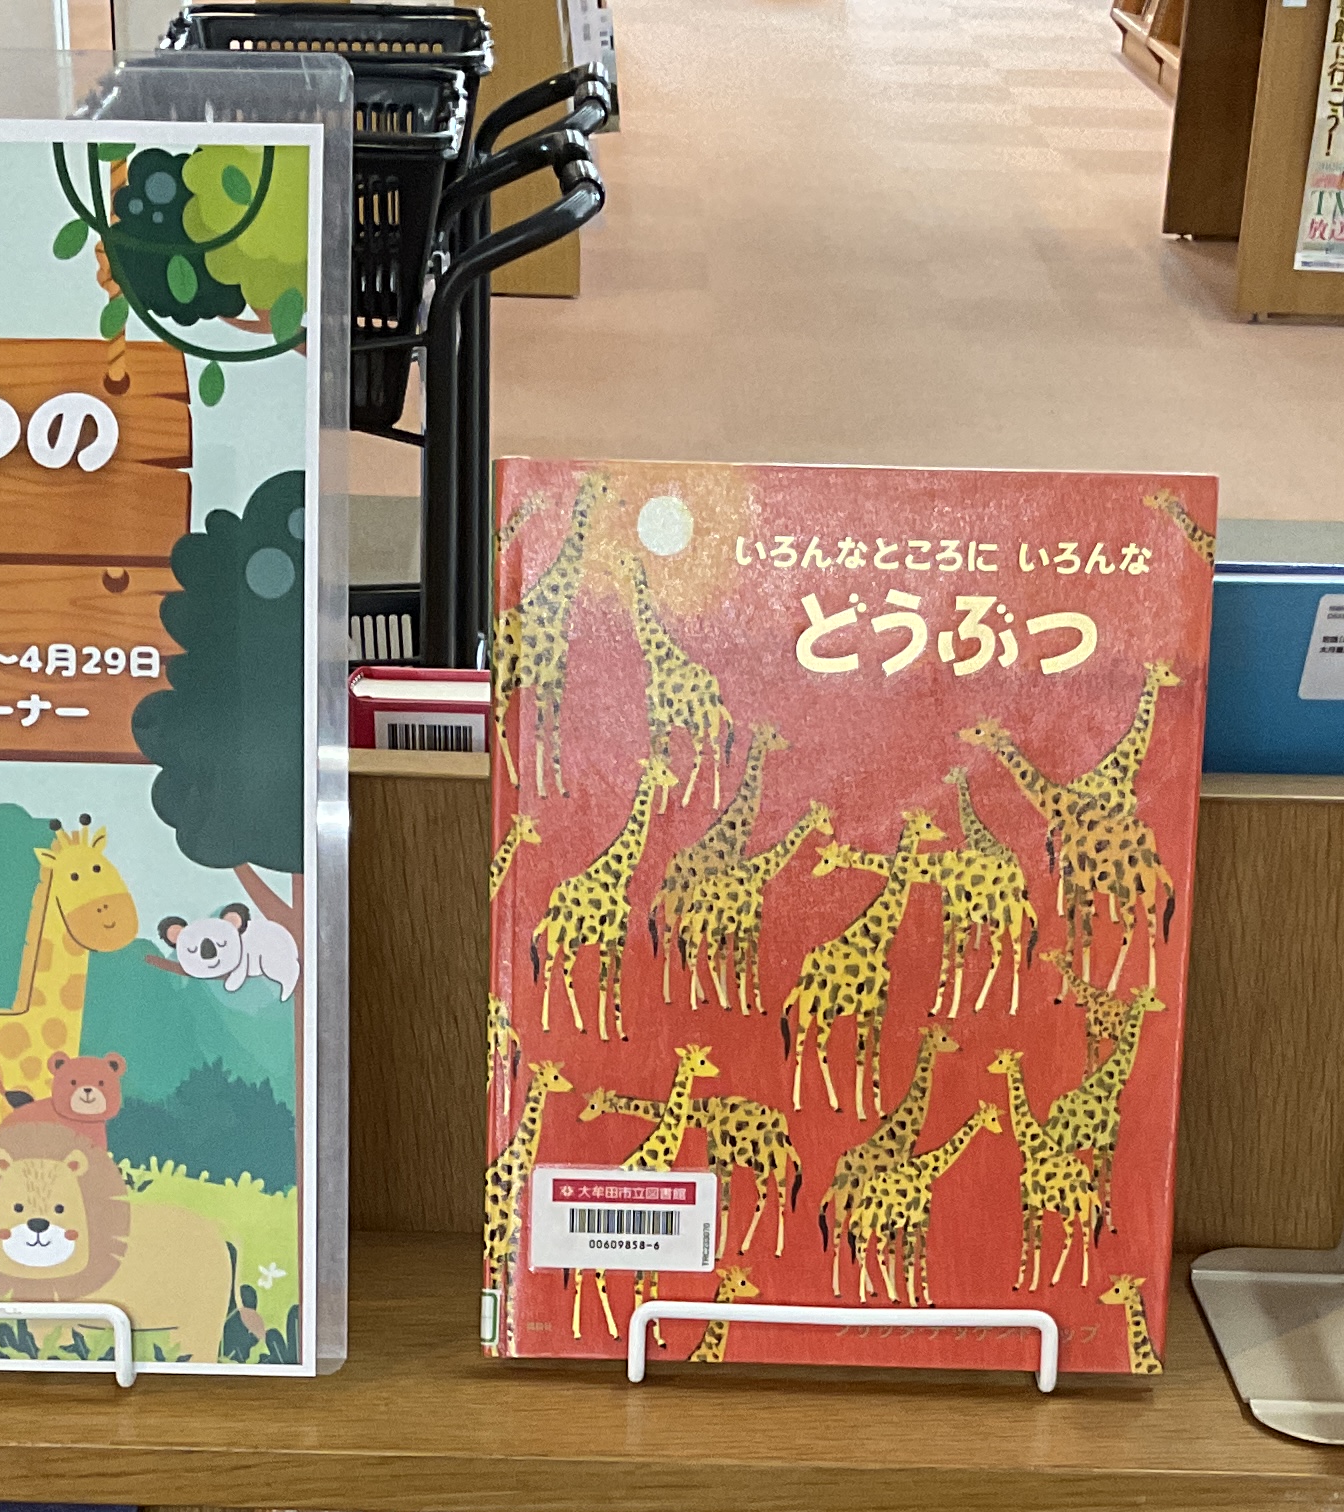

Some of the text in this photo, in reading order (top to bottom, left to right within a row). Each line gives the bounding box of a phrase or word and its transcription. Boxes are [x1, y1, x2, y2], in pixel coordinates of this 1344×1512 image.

[734, 533, 1153, 577] いろんなところに いろんな
[791, 592, 1099, 677] どうぶつ
[578, 1185, 687, 1201] 大牟田市立図書館
[589, 1239, 660, 1251] 00609858-6
